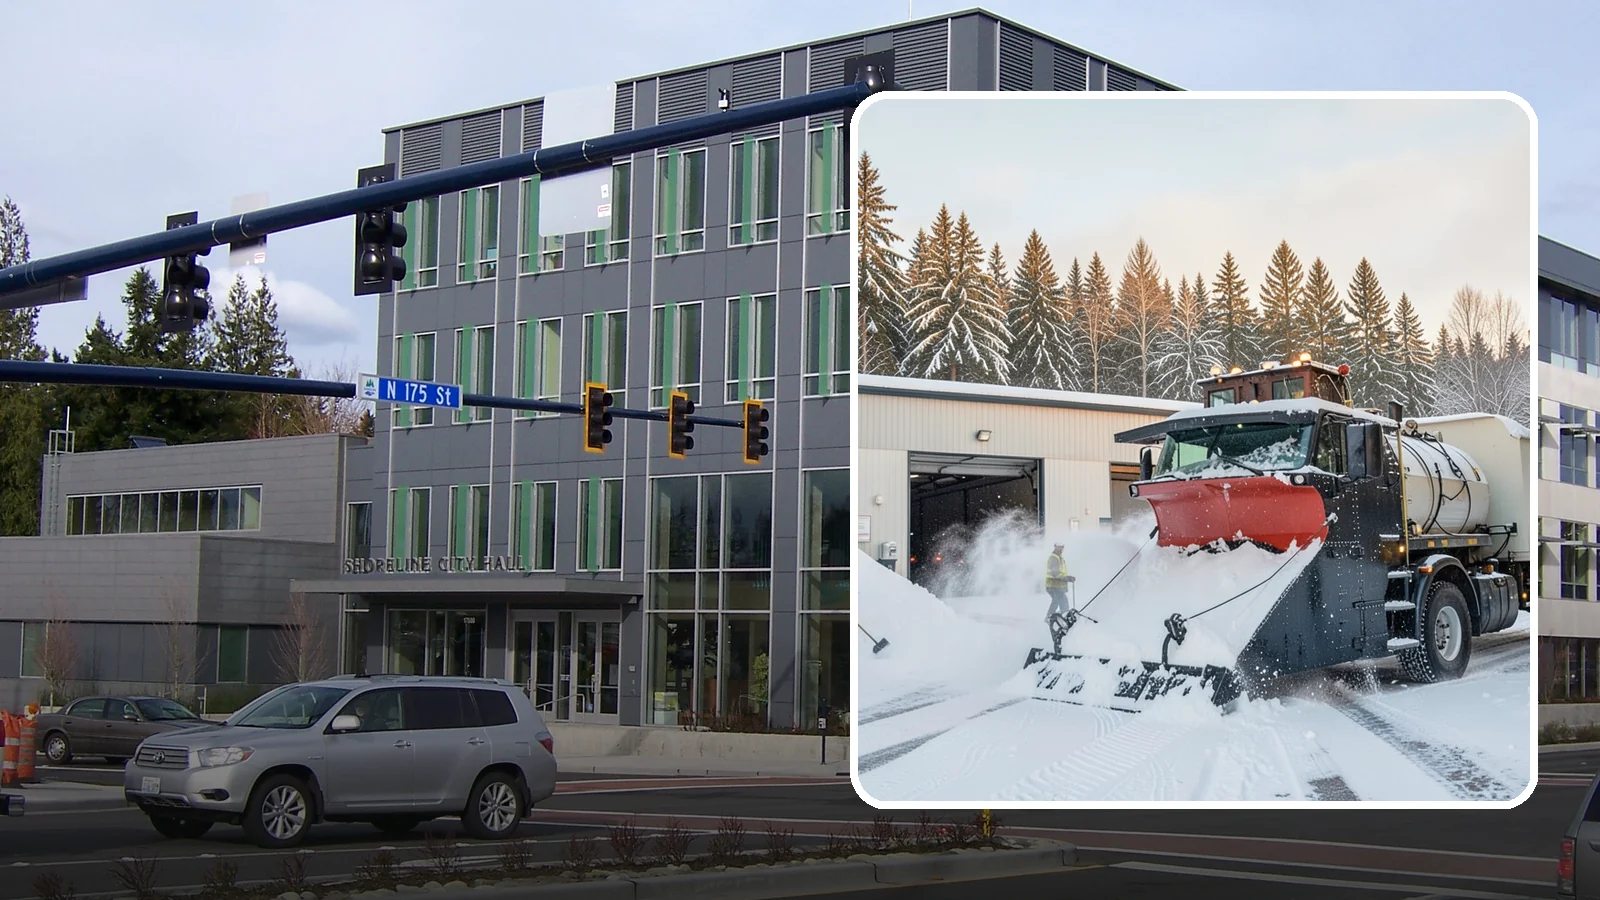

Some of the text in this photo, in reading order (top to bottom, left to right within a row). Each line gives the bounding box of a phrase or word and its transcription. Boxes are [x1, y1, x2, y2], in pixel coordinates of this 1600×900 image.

[387, 380, 451, 406] N 175 St
[343, 556, 525, 574] SHORELINE CITY HALL
